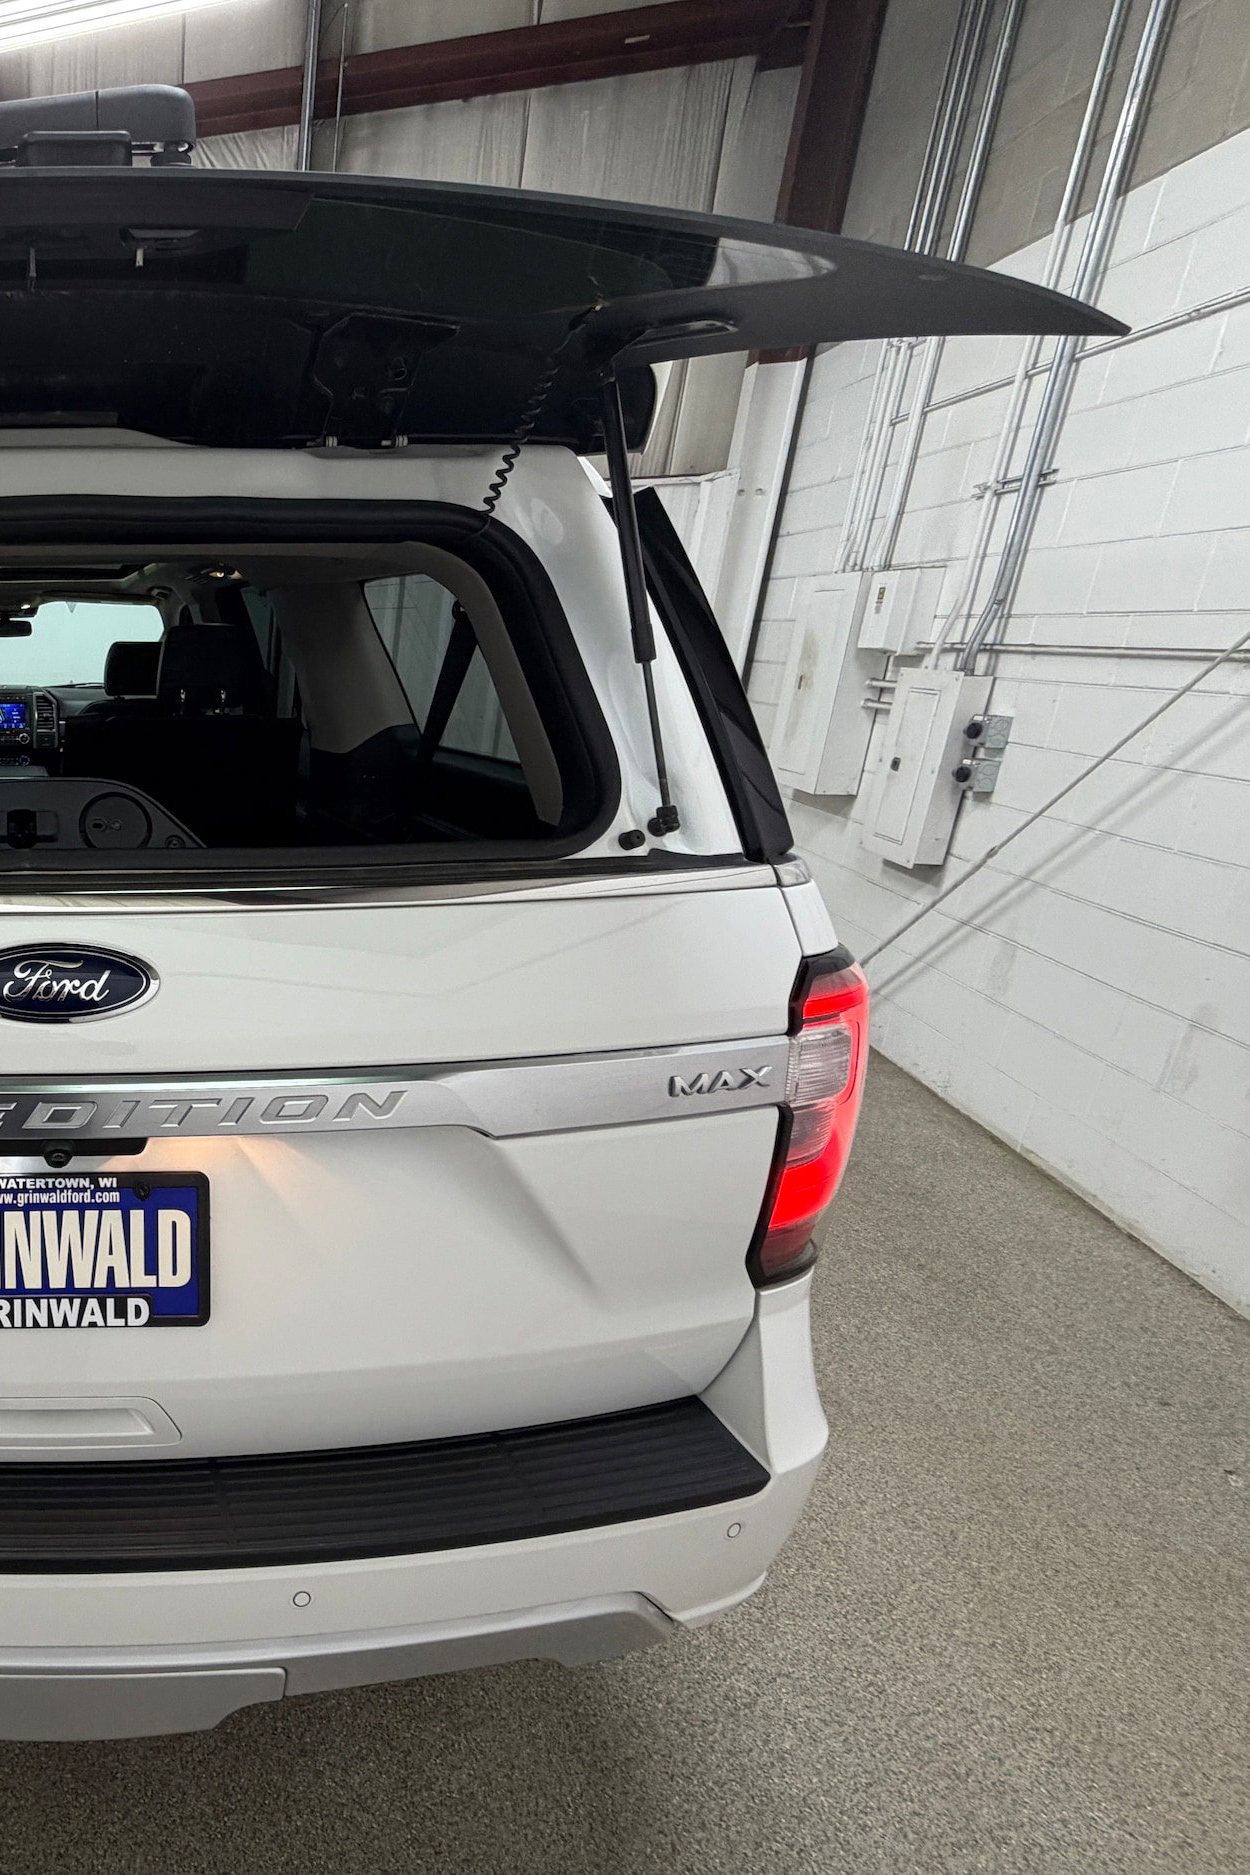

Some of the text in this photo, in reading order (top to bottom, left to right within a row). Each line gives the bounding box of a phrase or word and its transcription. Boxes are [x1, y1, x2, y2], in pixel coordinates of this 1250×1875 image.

[2, 959, 111, 1003] Ford
[668, 1065, 772, 1098] MAX
[98, 1177, 117, 1189] WI
